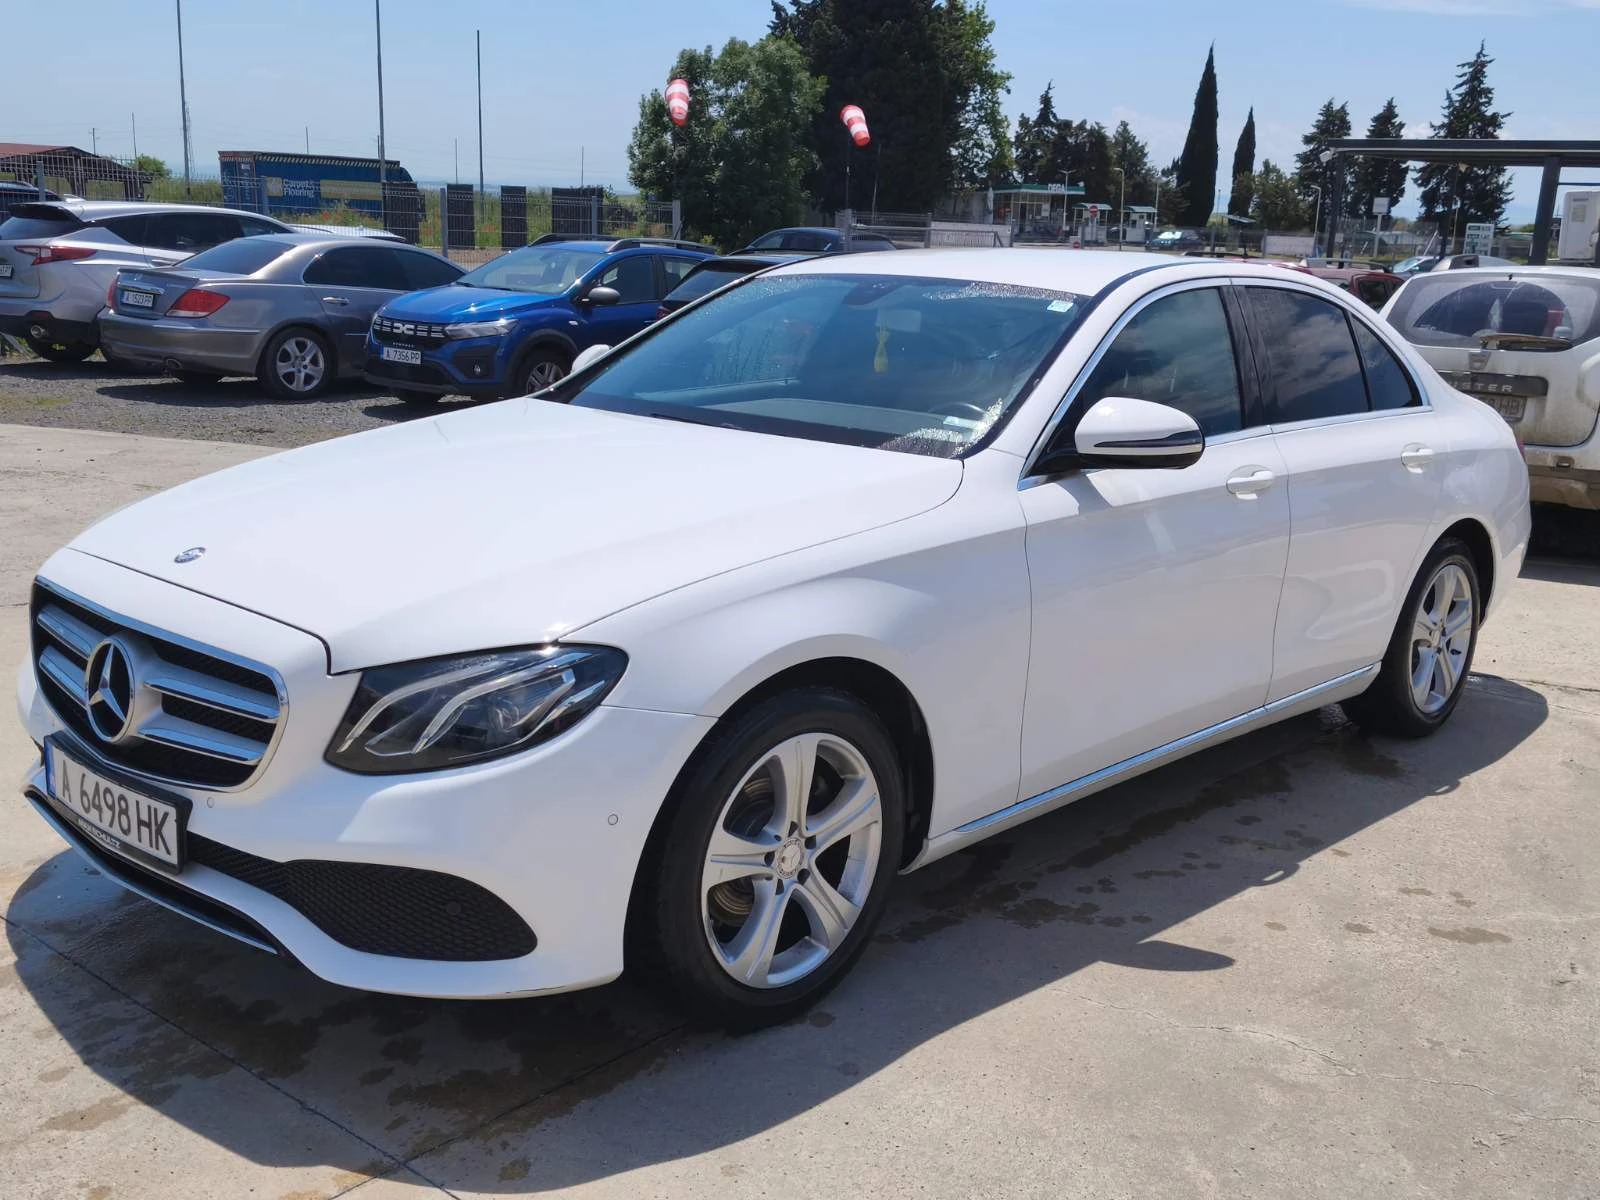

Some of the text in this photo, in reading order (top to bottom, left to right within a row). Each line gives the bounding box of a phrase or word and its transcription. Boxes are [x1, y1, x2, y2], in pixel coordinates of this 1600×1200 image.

[393, 349, 410, 362] 7356
[410, 351, 420, 363] PP
[61, 759, 72, 803] A
[79, 772, 132, 837] 6498
[135, 799, 172, 856] HK
